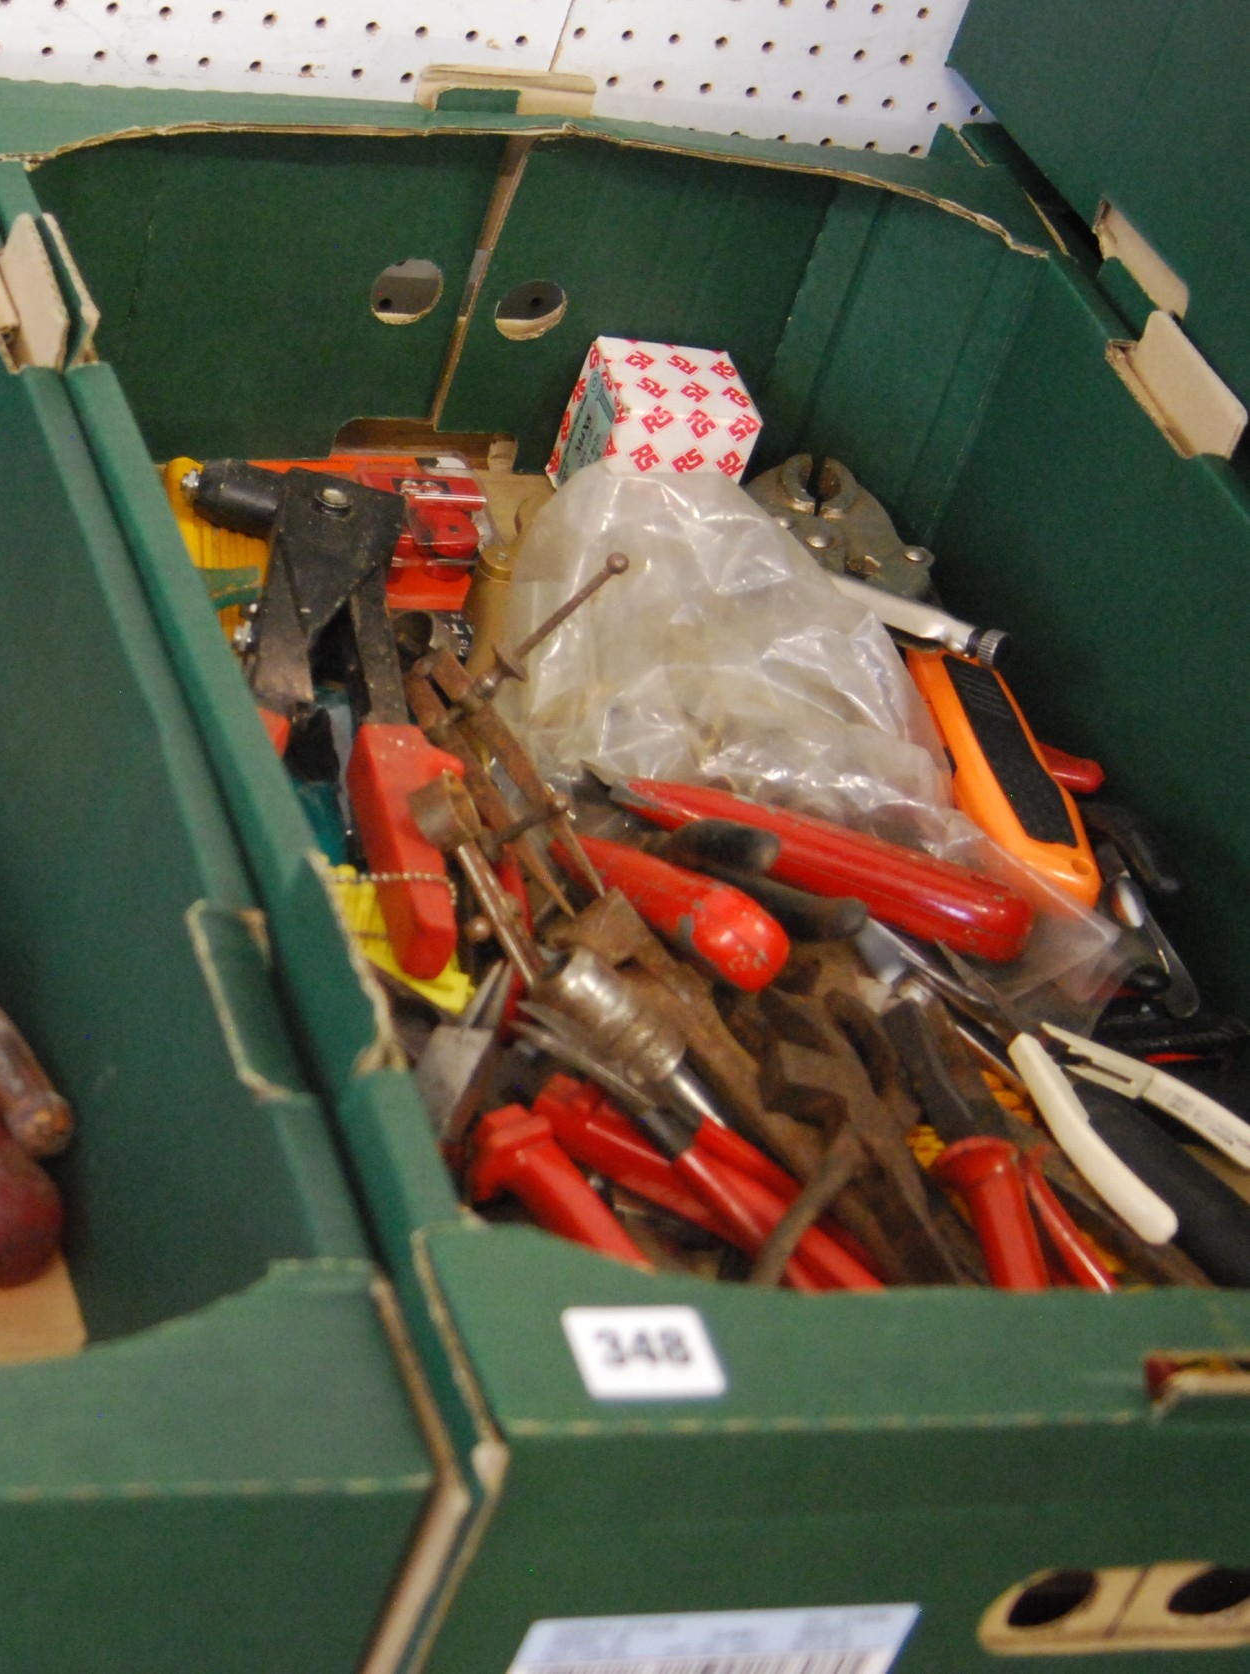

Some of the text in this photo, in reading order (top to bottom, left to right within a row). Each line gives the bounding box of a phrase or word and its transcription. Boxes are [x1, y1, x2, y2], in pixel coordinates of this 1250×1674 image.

[625, 350, 655, 370] RS
[667, 354, 699, 375] RS
[710, 360, 737, 380] RS
[636, 377, 669, 399] RS
[680, 381, 710, 403] RS
[721, 386, 750, 408] RS
[641, 405, 675, 434] RS
[686, 409, 717, 438] RS
[728, 414, 761, 442] RS
[630, 443, 661, 472] RS
[672, 447, 705, 473] RS
[715, 450, 745, 477] RS
[594, 1327, 693, 1369] 348
